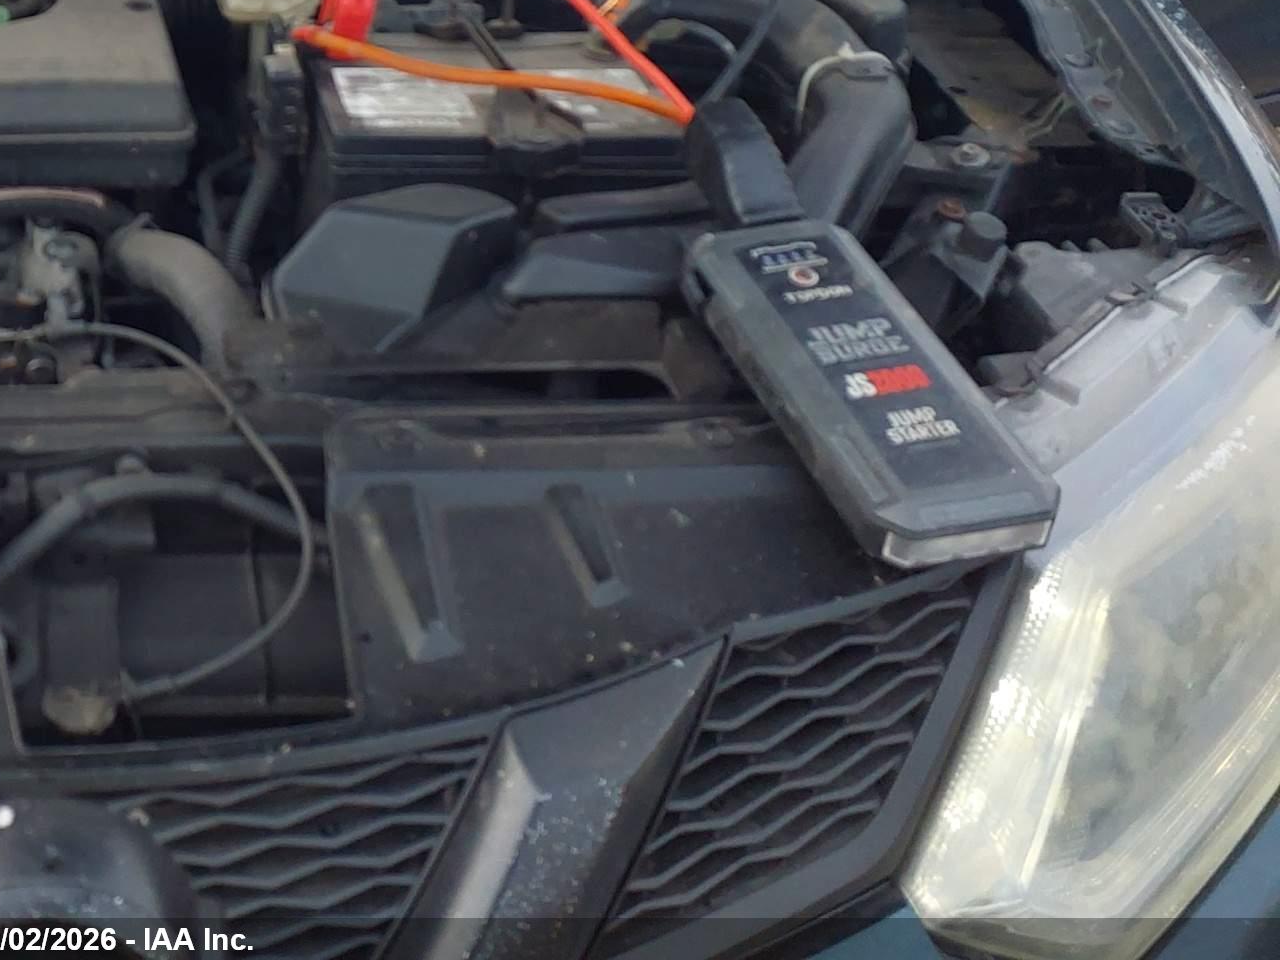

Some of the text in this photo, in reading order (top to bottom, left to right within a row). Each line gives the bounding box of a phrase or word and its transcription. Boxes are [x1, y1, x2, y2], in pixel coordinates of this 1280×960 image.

[808, 317, 892, 342] JUMP
[812, 336, 910, 364] SURGE
[886, 406, 936, 428] JUMP
[885, 419, 960, 444] STARTER
